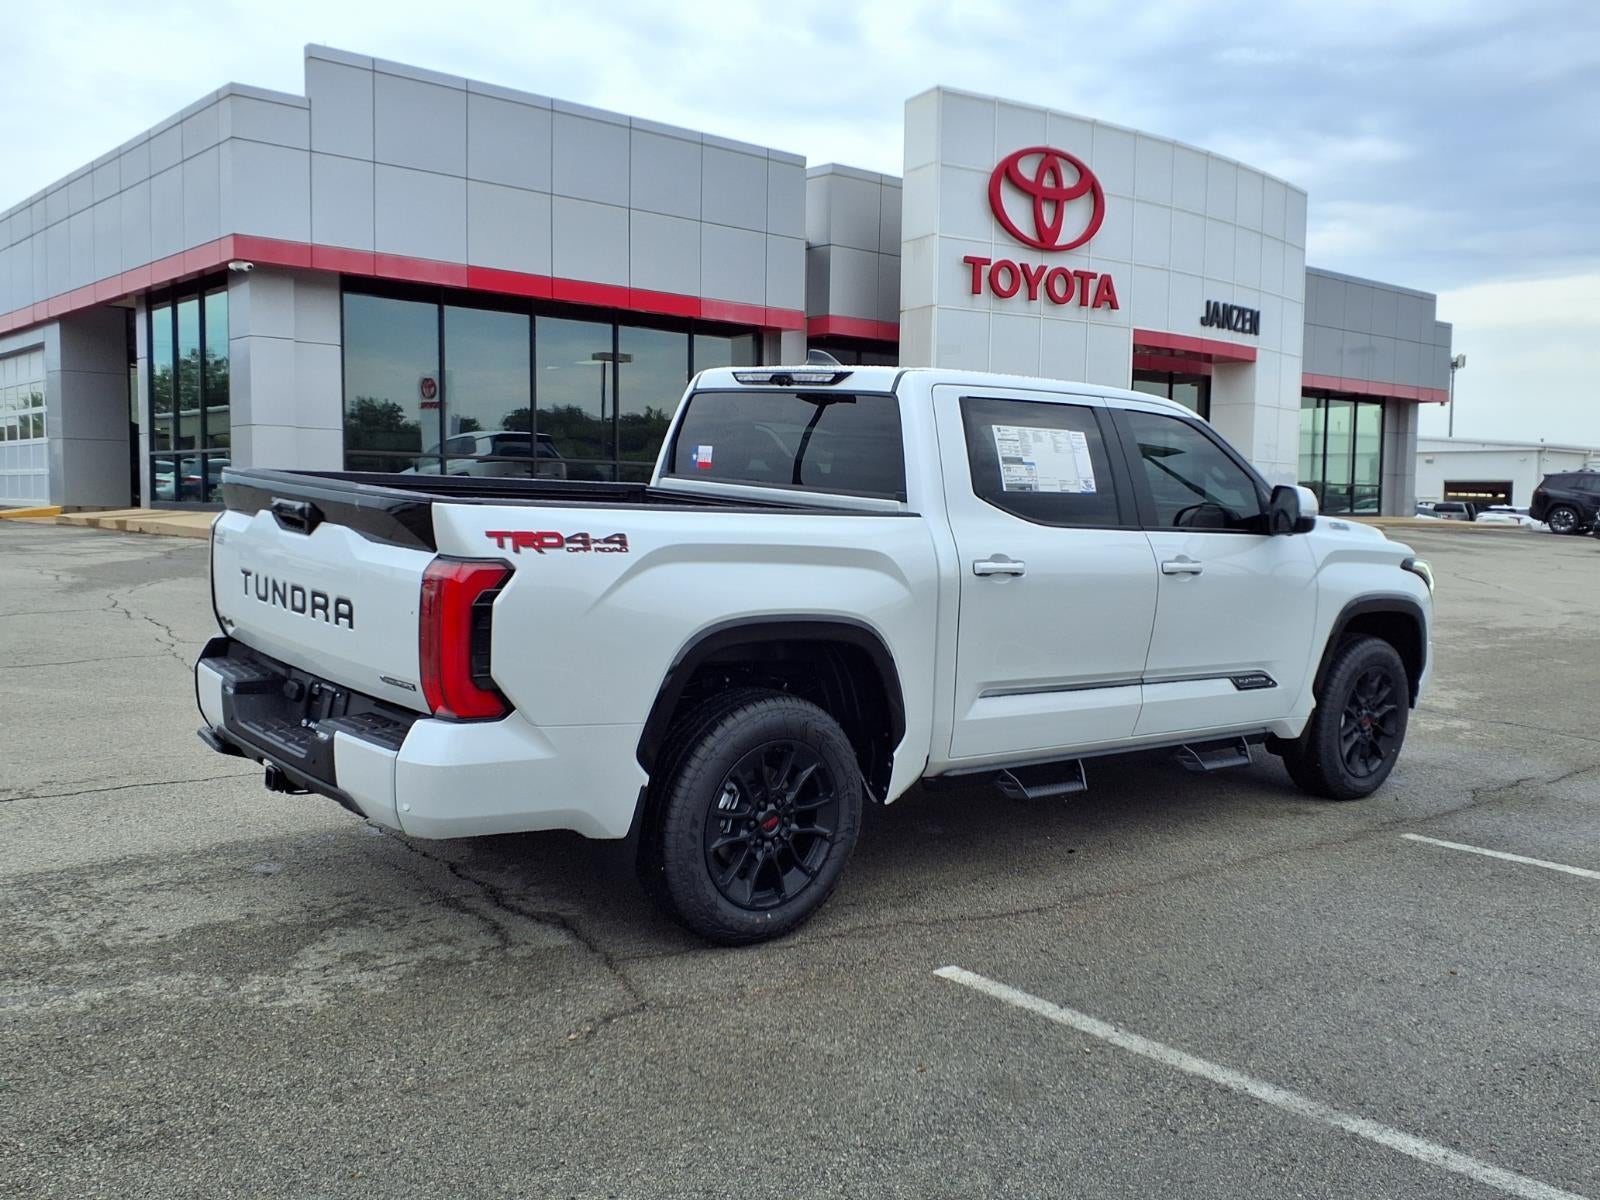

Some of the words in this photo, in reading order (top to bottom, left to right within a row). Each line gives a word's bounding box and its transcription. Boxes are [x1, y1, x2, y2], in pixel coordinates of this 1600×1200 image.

[963, 255, 1120, 311] TOYOTA
[1200, 300, 1260, 336] JANZEN
[485, 530, 565, 554] TRD
[240, 569, 355, 630] TUNDRA
